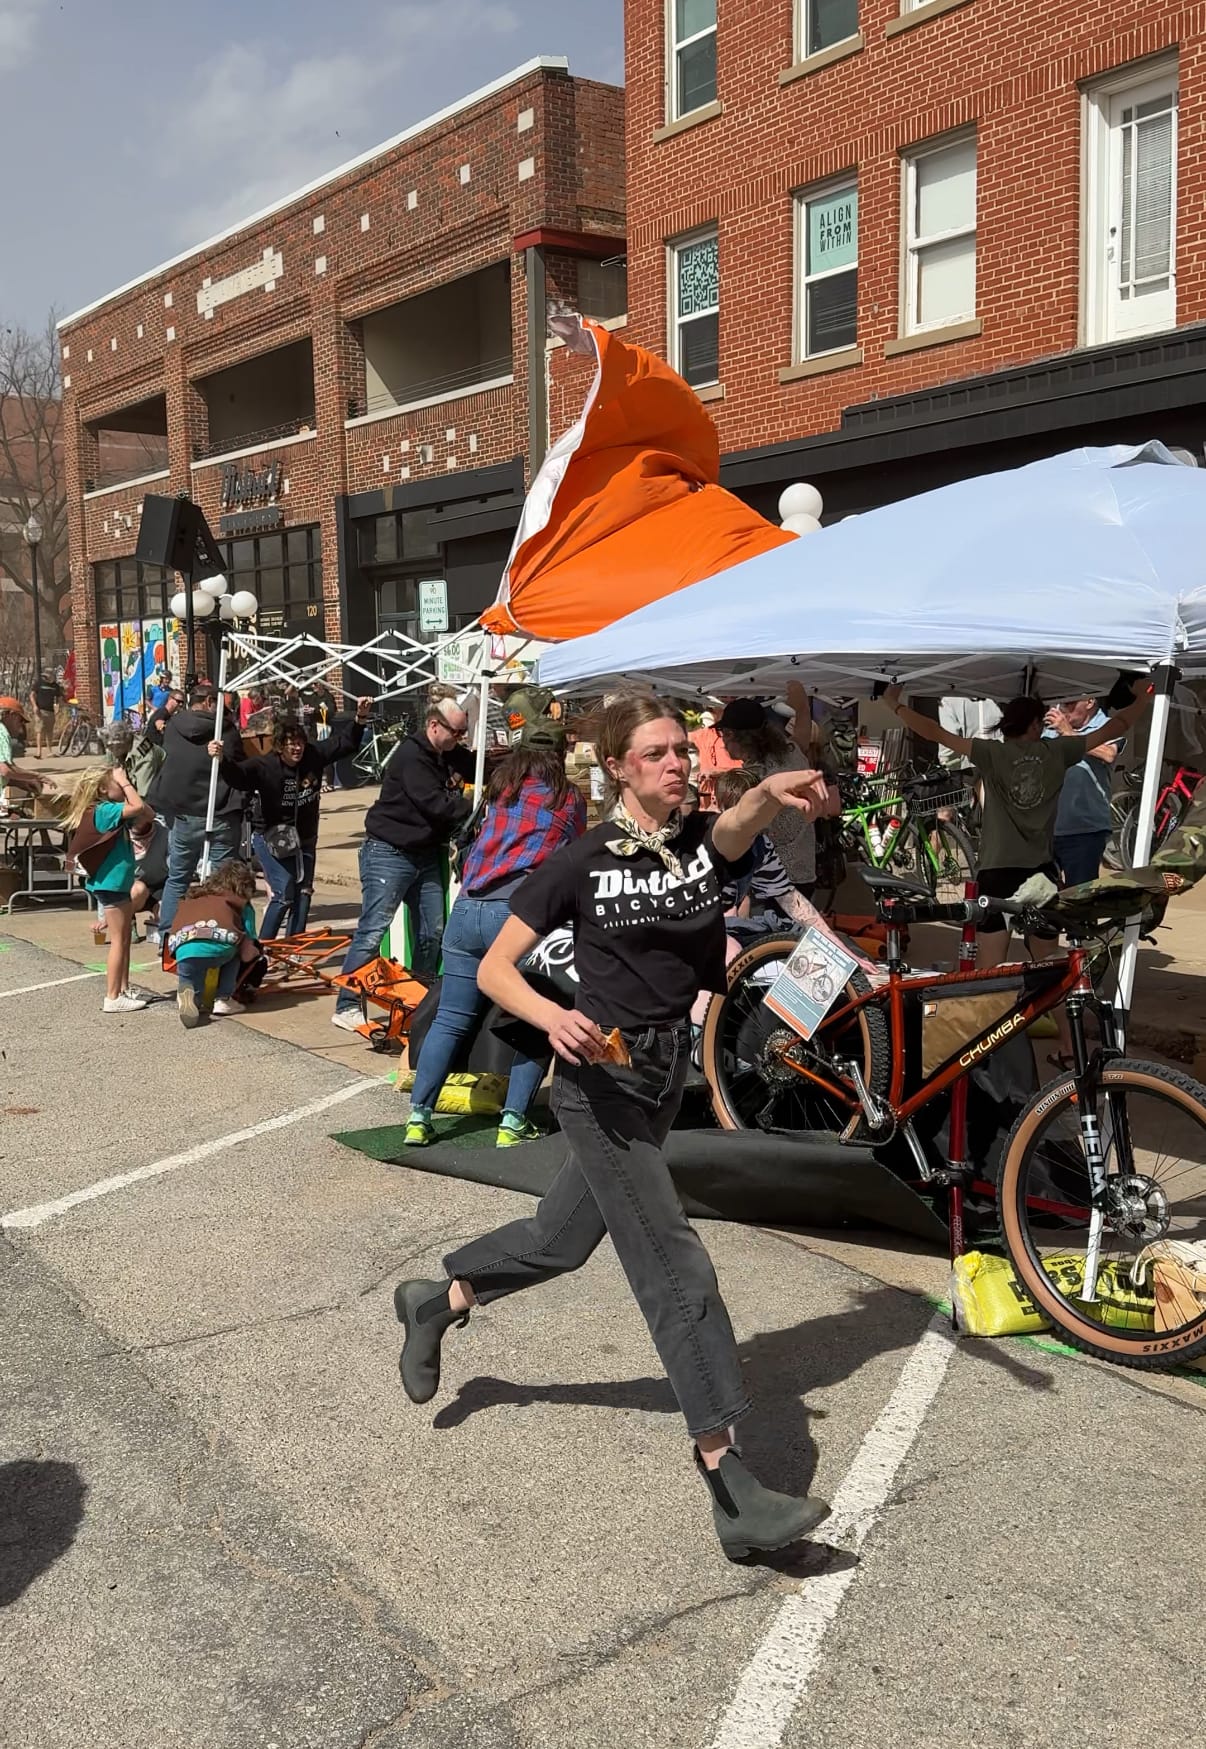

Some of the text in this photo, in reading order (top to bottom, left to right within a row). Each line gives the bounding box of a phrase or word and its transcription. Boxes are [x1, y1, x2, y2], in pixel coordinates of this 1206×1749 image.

[820, 203, 851, 229] ALIGN
[820, 222, 851, 240] FROM
[820, 231, 851, 252] WITHIN
[306, 604, 318, 617] 120
[422, 606, 445, 614] PARKING
[423, 596, 445, 605] MINUTE
[595, 876, 718, 916] BICYCLE
[678, 893, 722, 918] oklahom
[727, 954, 754, 983] AXXIS
[959, 1013, 1026, 1067] CHUMBA
[1080, 1114, 1107, 1199] HELM
[1143, 1325, 1204, 1353] MAXXIS
